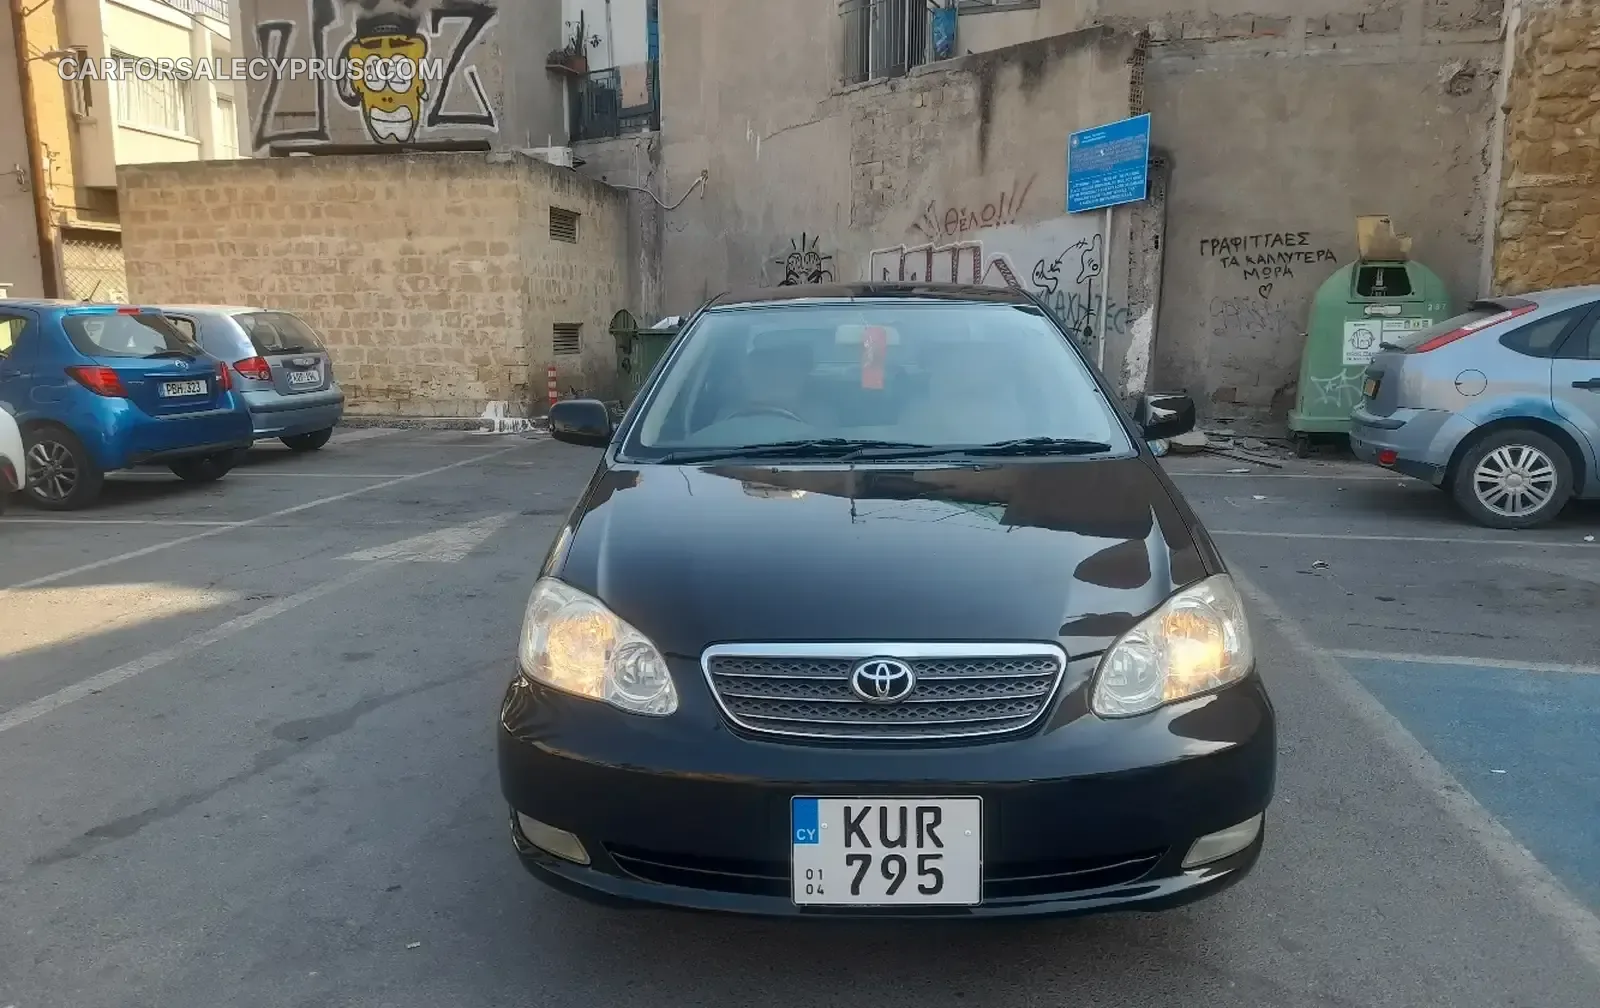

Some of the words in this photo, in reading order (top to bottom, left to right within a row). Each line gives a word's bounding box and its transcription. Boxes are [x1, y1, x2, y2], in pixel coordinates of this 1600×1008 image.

[843, 805, 945, 849] KUR
[796, 828, 816, 841] CY
[805, 868, 824, 881] 01
[845, 853, 945, 896] 795
[805, 883, 825, 895] 04
